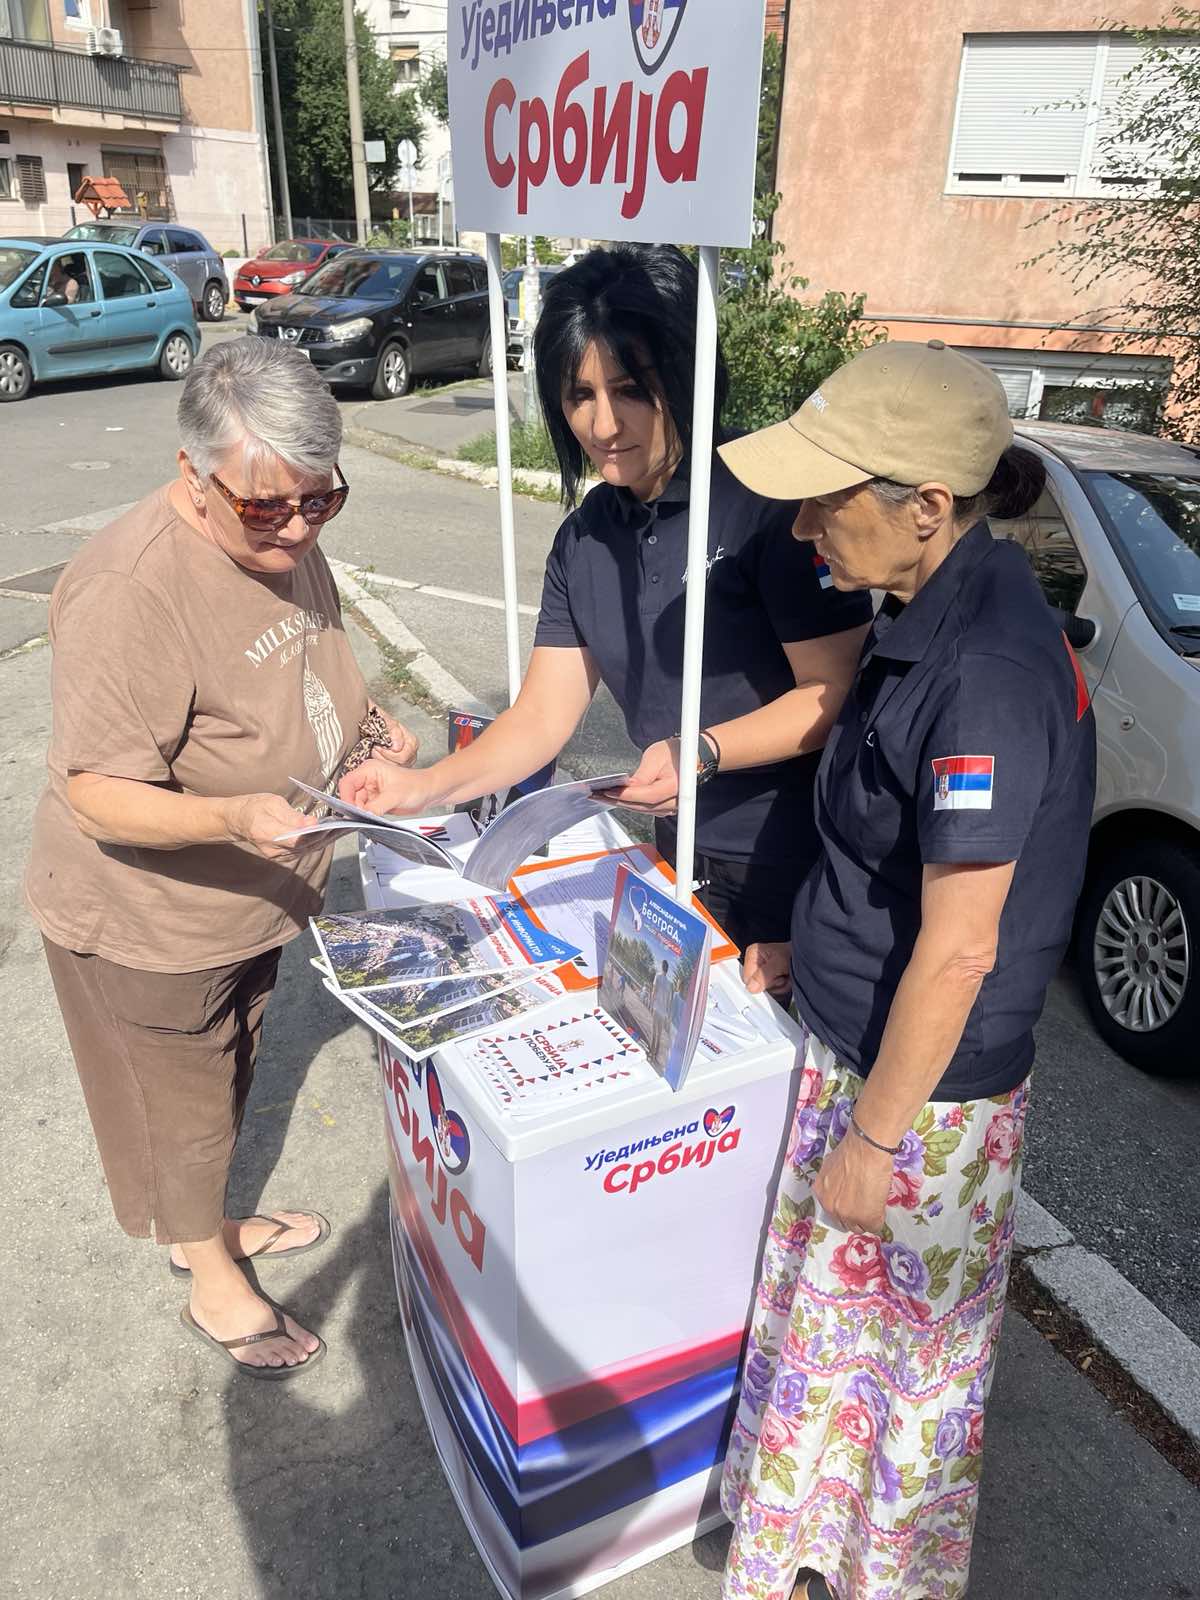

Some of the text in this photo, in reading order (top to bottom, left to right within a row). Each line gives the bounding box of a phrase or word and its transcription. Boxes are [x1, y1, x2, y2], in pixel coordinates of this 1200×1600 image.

[484, 49, 709, 220] Србија
[524, 1037, 558, 1073] ПОБЕЂУЈЕ
[535, 1035, 568, 1069] СРБИЈА
[379, 1037, 486, 1273] рбија
[584, 1120, 699, 1171] Уједињена
[603, 1128, 741, 1193] Србија
